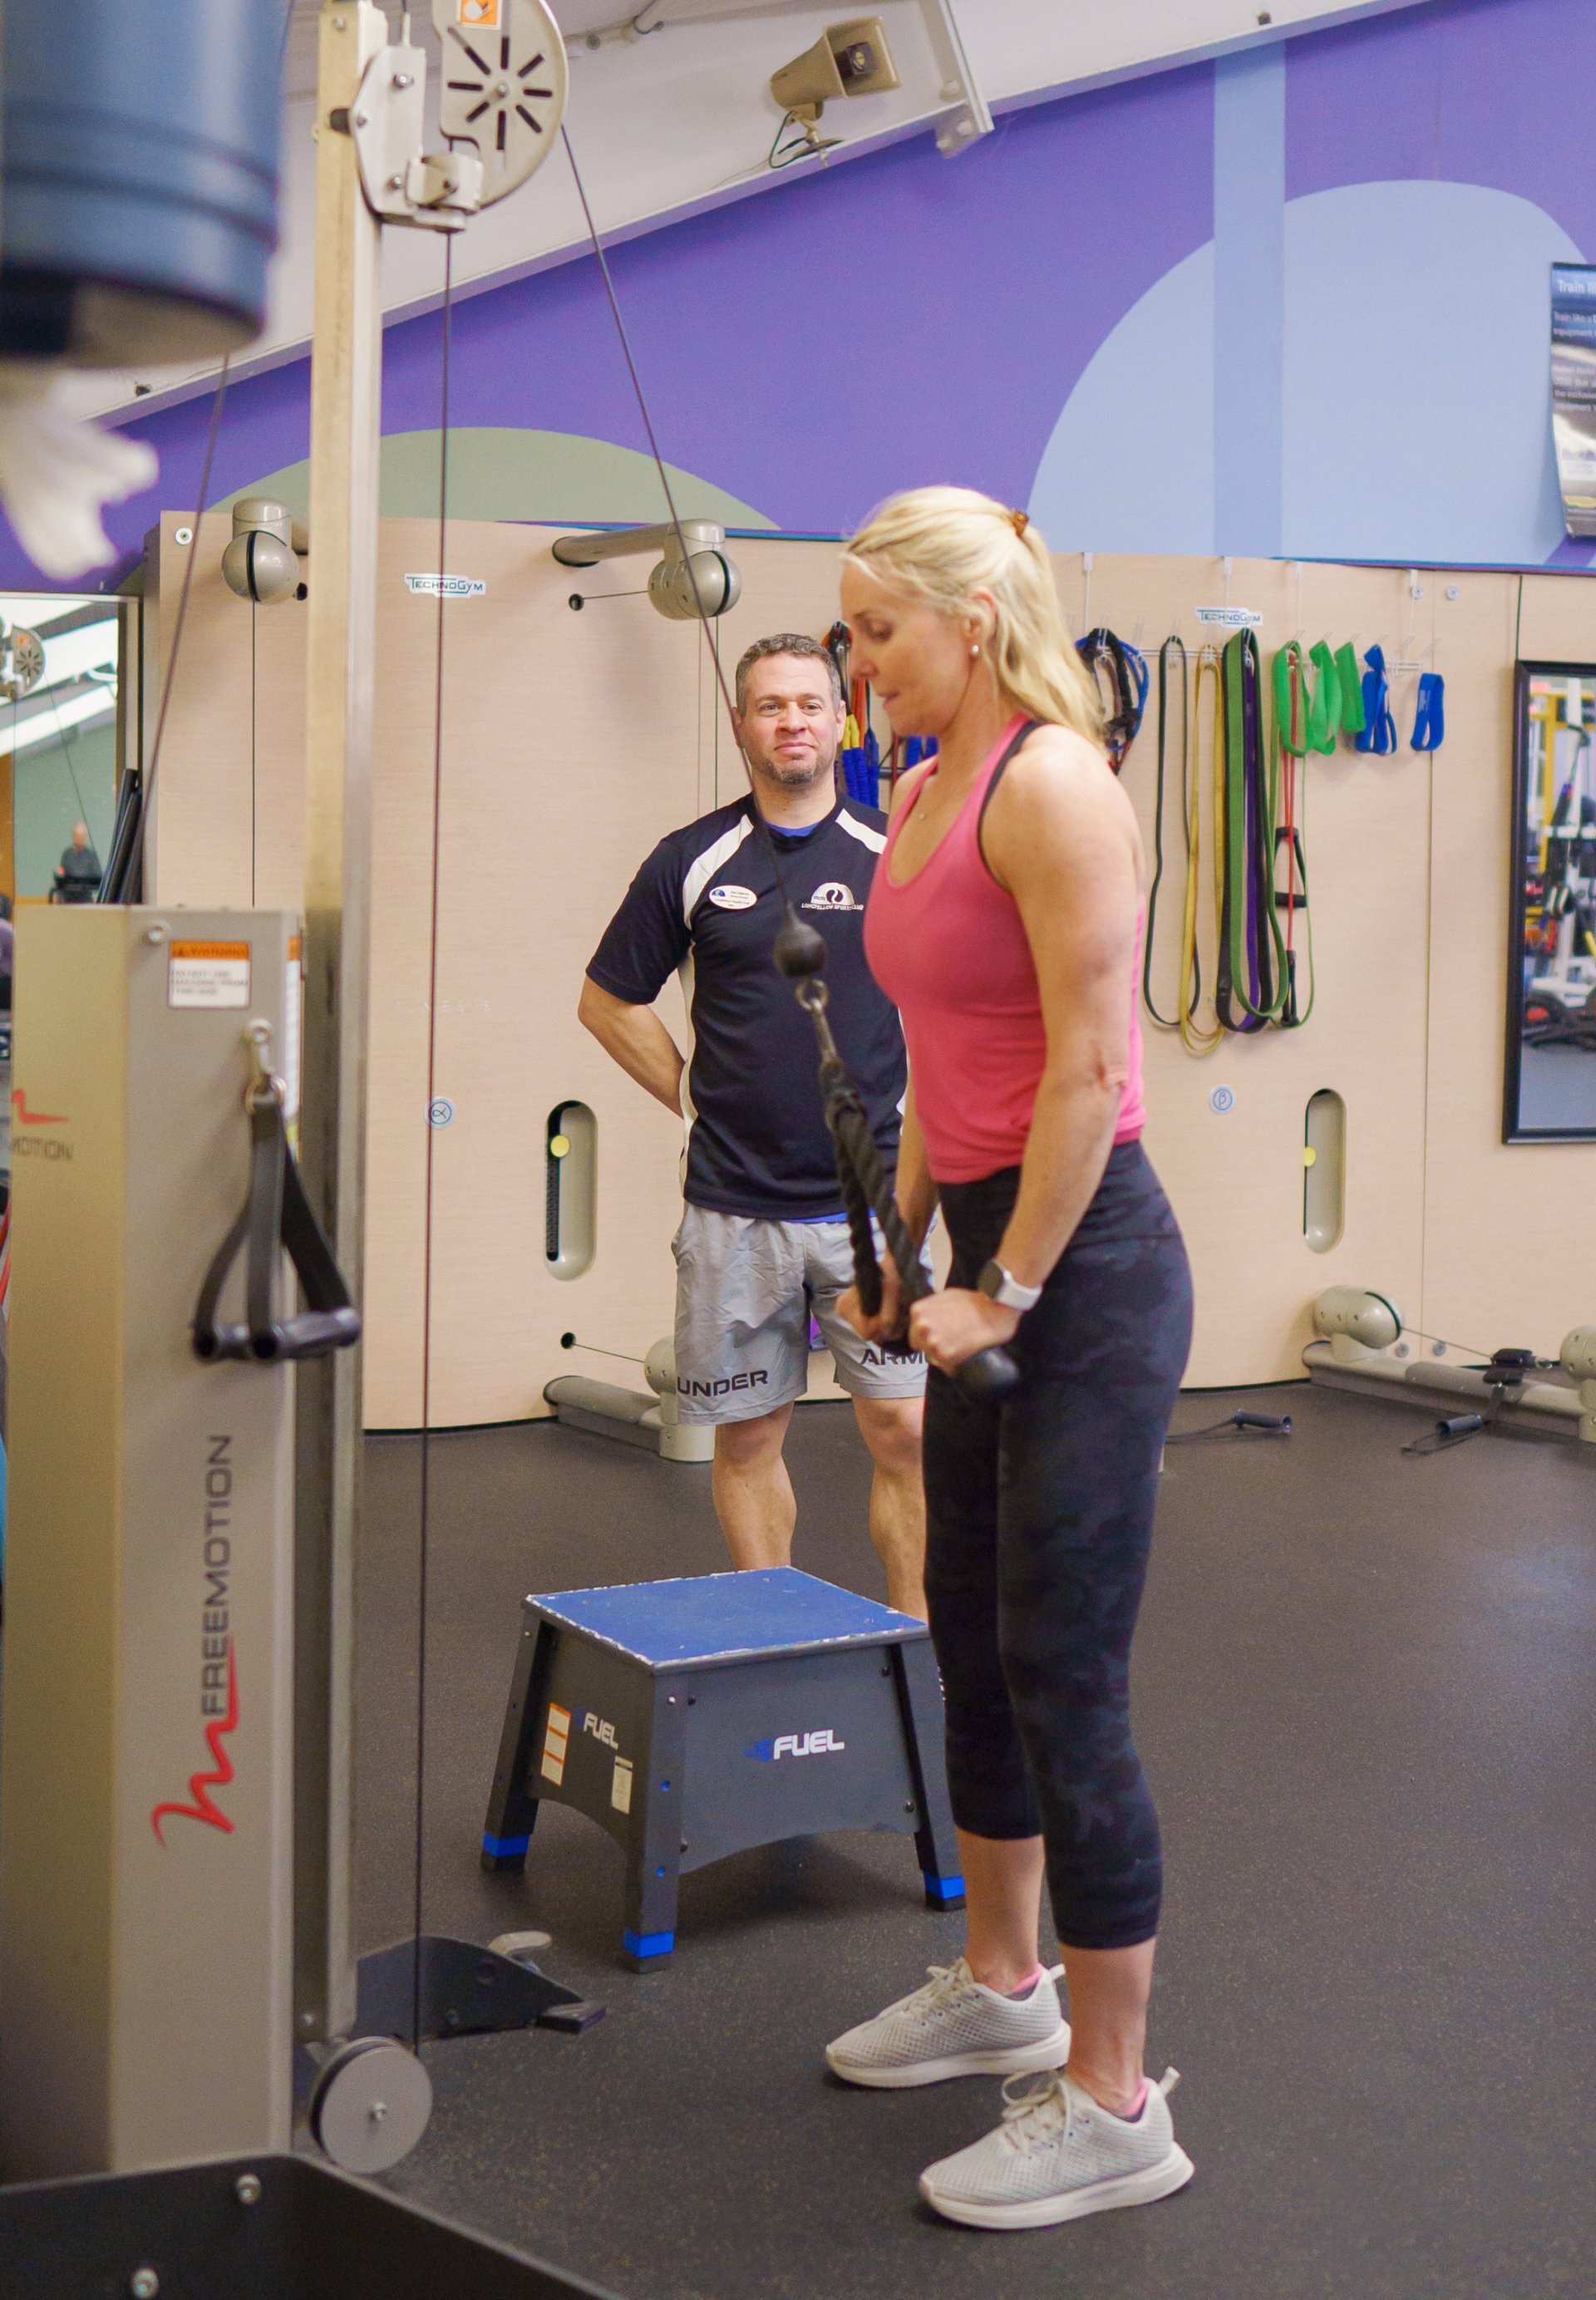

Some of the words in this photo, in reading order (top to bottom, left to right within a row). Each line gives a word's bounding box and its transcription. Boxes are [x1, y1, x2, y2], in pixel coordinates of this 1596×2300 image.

[406, 577, 483, 593] TECHNOGYM
[860, 1348, 924, 1366] ARM
[677, 1370, 768, 1397] UNDER
[200, 1434, 234, 1716] FREEMOTION
[584, 1711, 619, 1751] FUEL
[773, 1729, 845, 1761] FUEL
